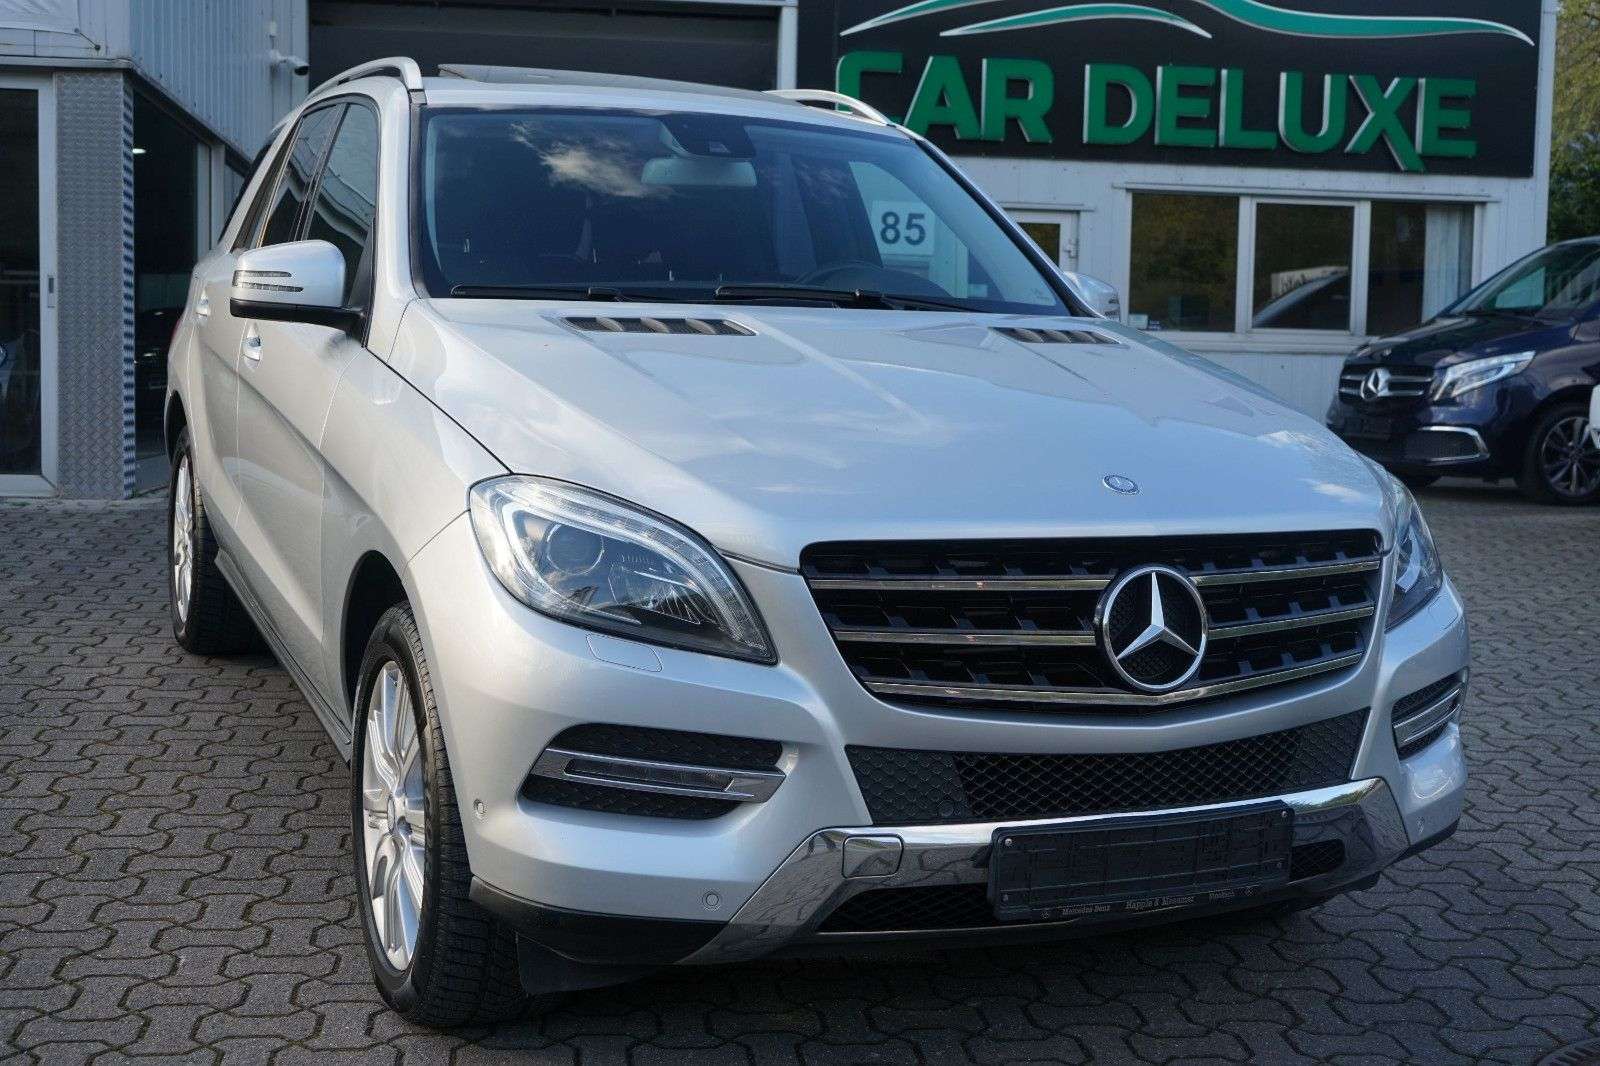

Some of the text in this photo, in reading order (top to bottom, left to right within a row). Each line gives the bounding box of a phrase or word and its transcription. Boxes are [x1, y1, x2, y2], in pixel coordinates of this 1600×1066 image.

[836, 51, 1478, 173] CAR DELUXE
[880, 211, 926, 246] 85
